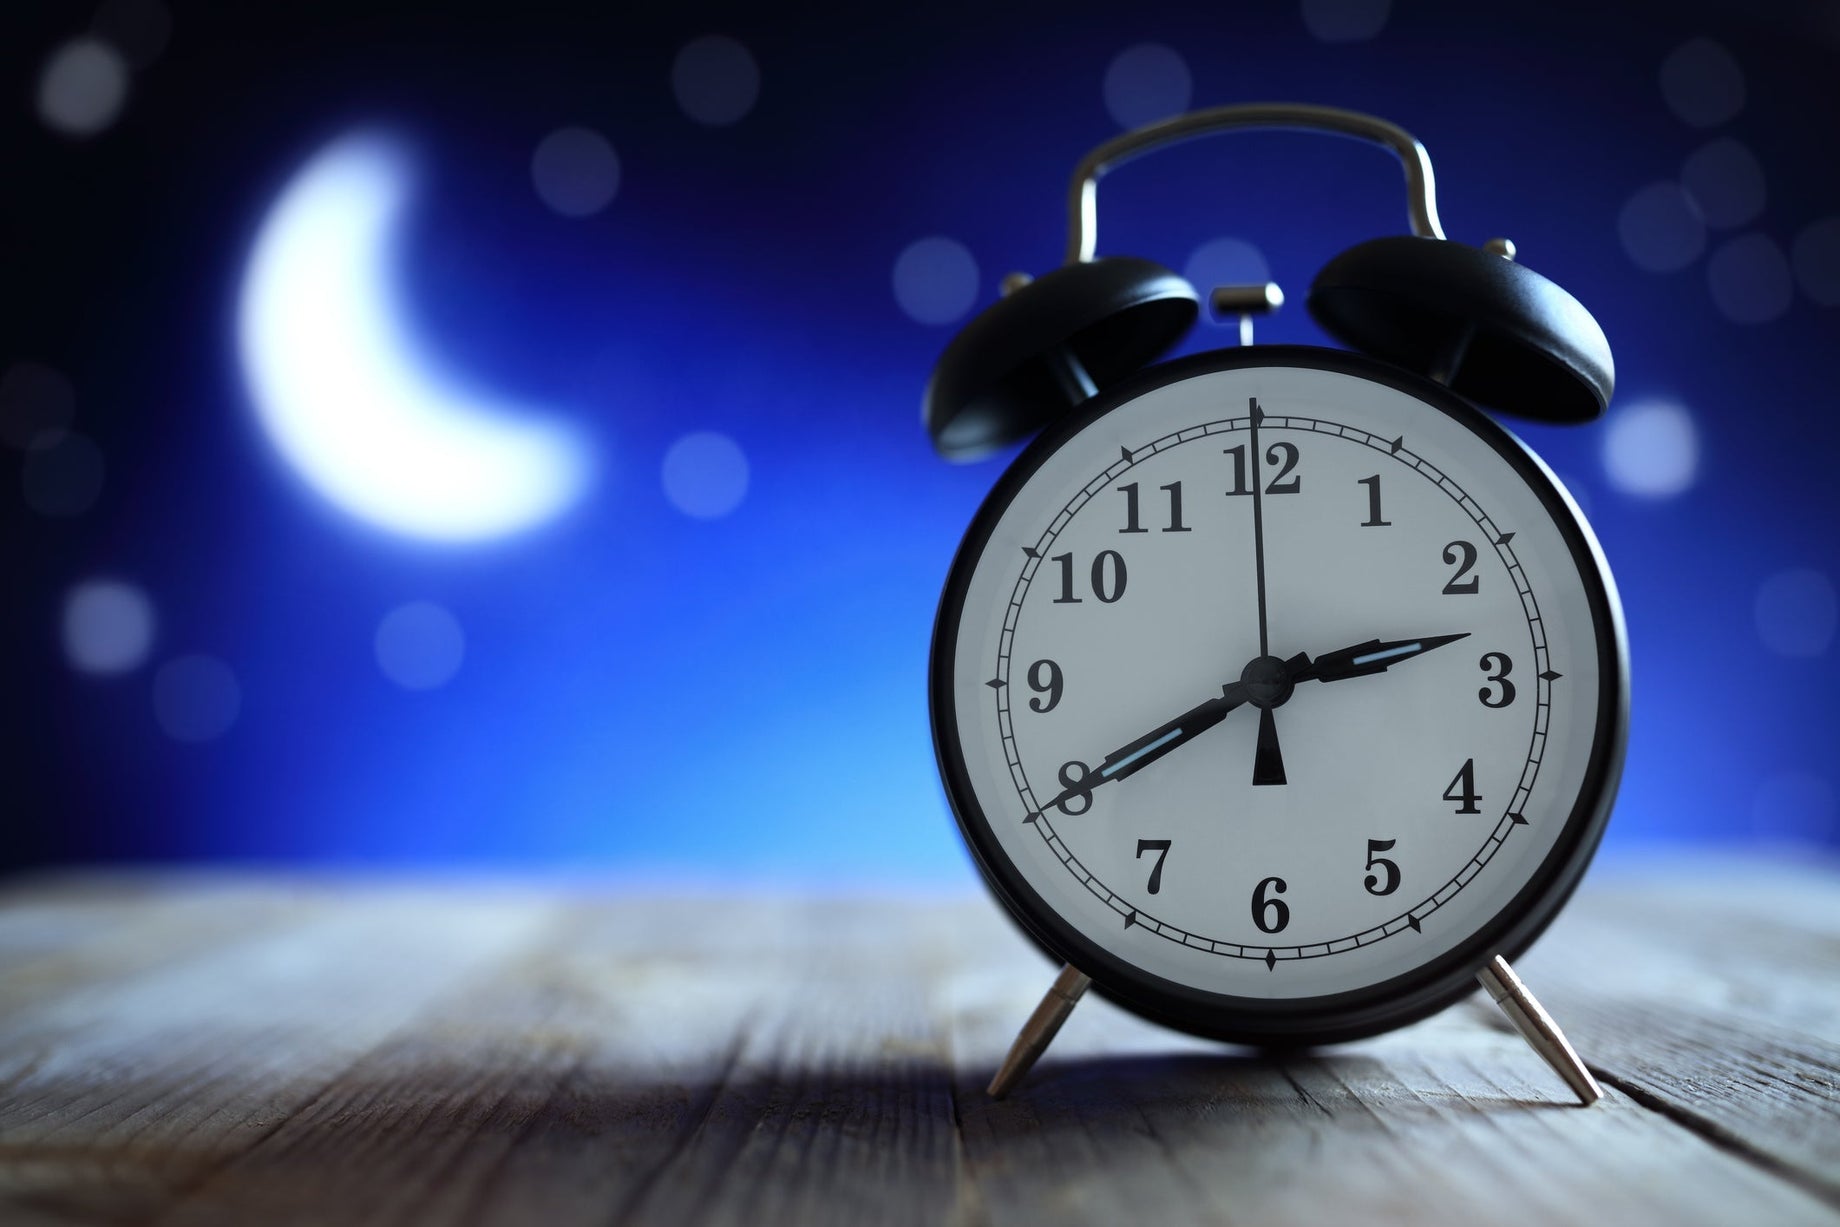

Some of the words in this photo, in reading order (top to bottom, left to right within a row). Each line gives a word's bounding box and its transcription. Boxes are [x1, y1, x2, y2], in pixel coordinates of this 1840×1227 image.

[1223, 441, 1302, 496] 12
[1116, 481, 1192, 533] 11
[1357, 474, 1392, 527] 1
[1051, 549, 1128, 604] 10
[1441, 540, 1480, 595] 2
[1027, 659, 1064, 714] 9
[1478, 651, 1517, 709] 3
[1057, 760, 1094, 816] 8
[1442, 758, 1483, 815] 4
[1135, 838, 1172, 896] 7
[1363, 838, 1402, 897] 5
[1251, 876, 1290, 934] 6
